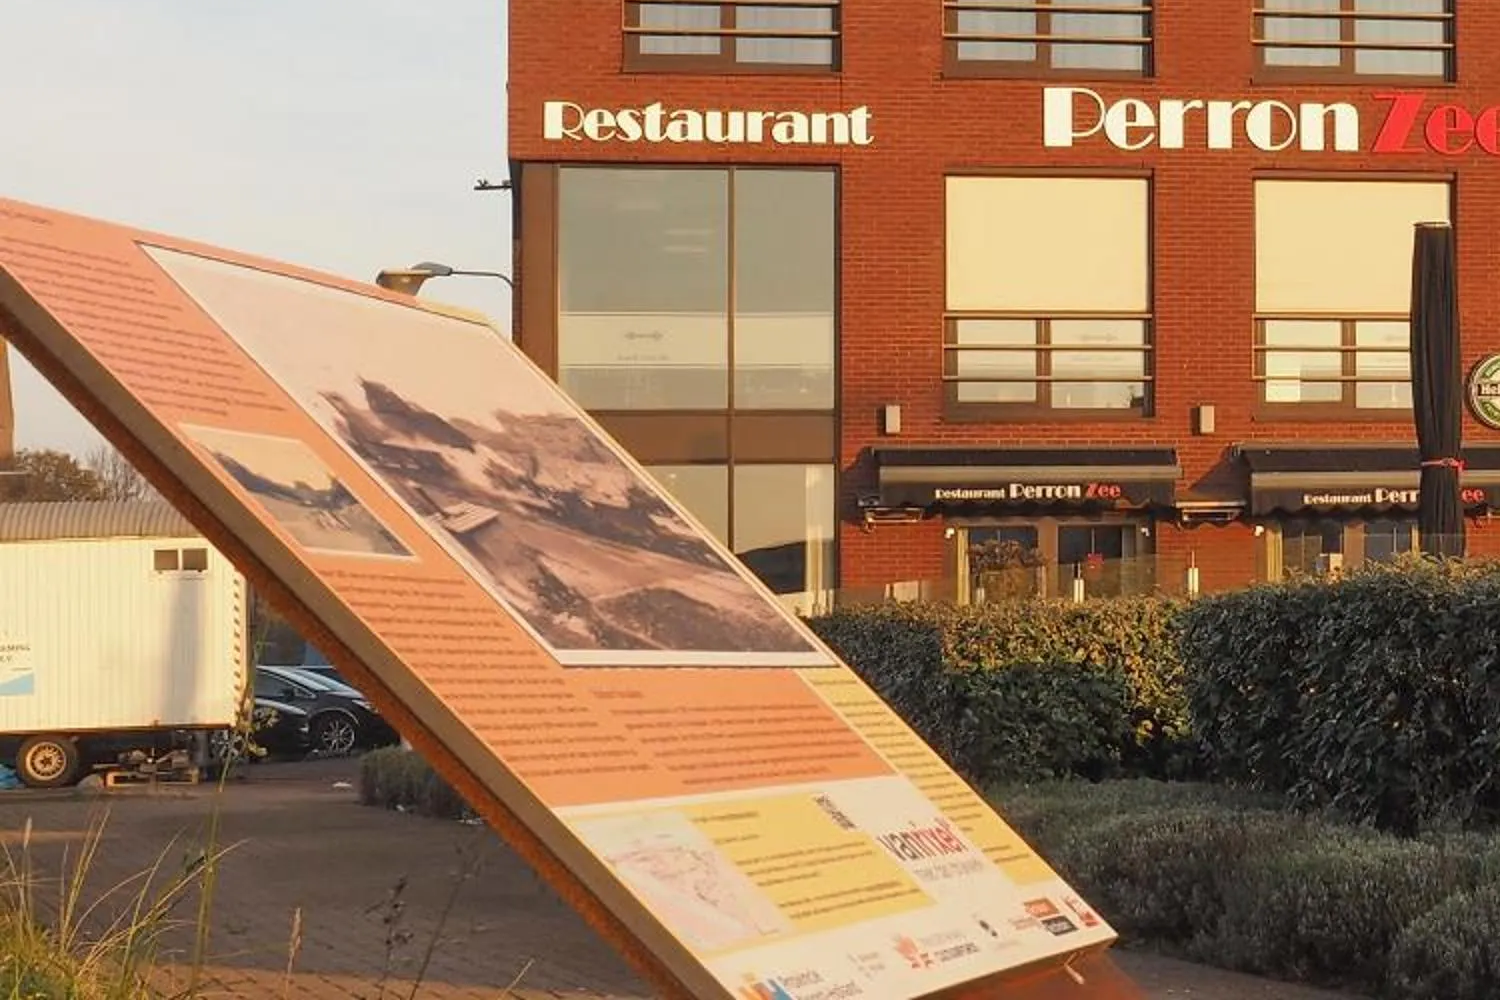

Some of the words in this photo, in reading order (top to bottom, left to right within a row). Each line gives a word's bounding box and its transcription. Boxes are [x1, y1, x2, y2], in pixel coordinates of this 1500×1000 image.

[543, 101, 875, 146] Restaurant
[1042, 87, 1360, 152] Perron
[934, 488, 1005, 499] Restaurant
[1009, 483, 1081, 499] Perron
[1086, 482, 1121, 498] Zee
[1303, 494, 1371, 504] Restaurant
[1375, 488, 1419, 503] Perr
[1461, 489, 1485, 503] ee
